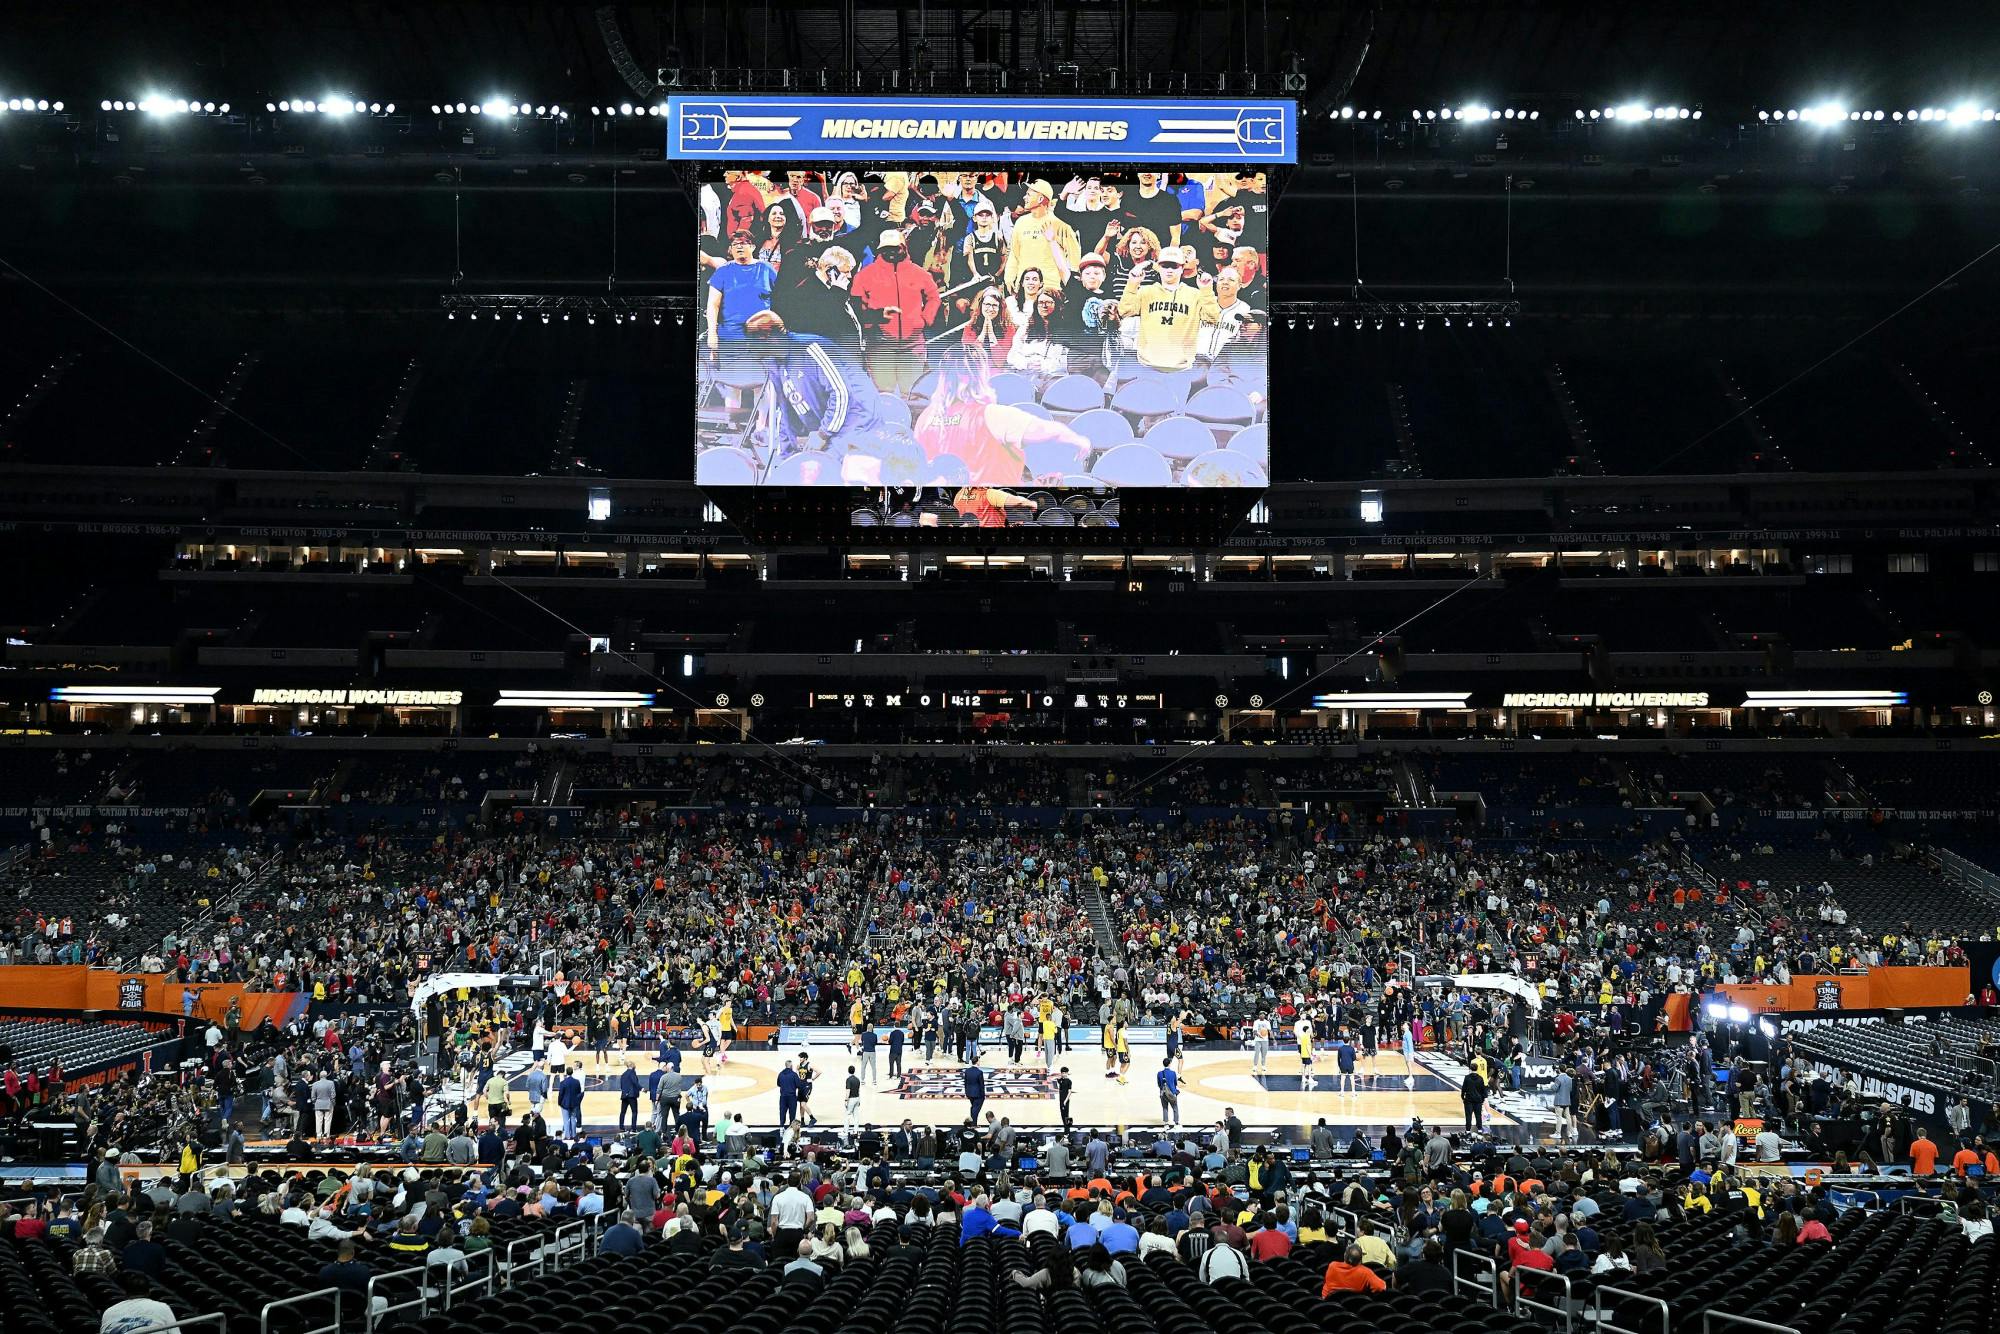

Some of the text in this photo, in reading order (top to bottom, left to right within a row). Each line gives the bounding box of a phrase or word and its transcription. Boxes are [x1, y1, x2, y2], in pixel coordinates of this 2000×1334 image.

[821, 119, 1129, 141] MICHIGAN WOLVERINES
[1149, 301, 1190, 315] MICHIGAN
[1161, 316, 1173, 326] M
[102, 524, 139, 534] BROOKS
[272, 529, 307, 538] HINTON
[1899, 529, 1921, 538] BILL
[614, 536, 720, 545] JIM HARBAUGH 1994-97
[1381, 536, 1402, 545] ERIC
[1405, 536, 1456, 545] DICKERSON
[1550, 534, 1599, 544] MARSHALL
[1728, 531, 1750, 541] JEFF
[1753, 531, 1800, 541] SATURDAY
[1258, 538, 1288, 547] JAMES
[1292, 538, 1326, 547] 1999-05
[252, 688, 463, 705] MICHIGAN WOLVERINES
[886, 695, 901, 706] M
[920, 695, 931, 706] 0
[951, 695, 981, 706] 4:12
[1503, 692, 1709, 707] MICHIGAN WOLVERINES
[844, 700, 853, 708] 0
[864, 700, 873, 708] 4
[1042, 696, 1053, 707] 0
[1100, 700, 1108, 708] 4
[1118, 700, 1127, 708] 0
[418, 960, 428, 968] 30
[1526, 960, 1536, 969] 30
[121, 984, 143, 993] FINAL
[1817, 987, 1839, 995] FINAL
[121, 1000, 142, 1008] FOUR
[1818, 1002, 1839, 1010] FOUR
